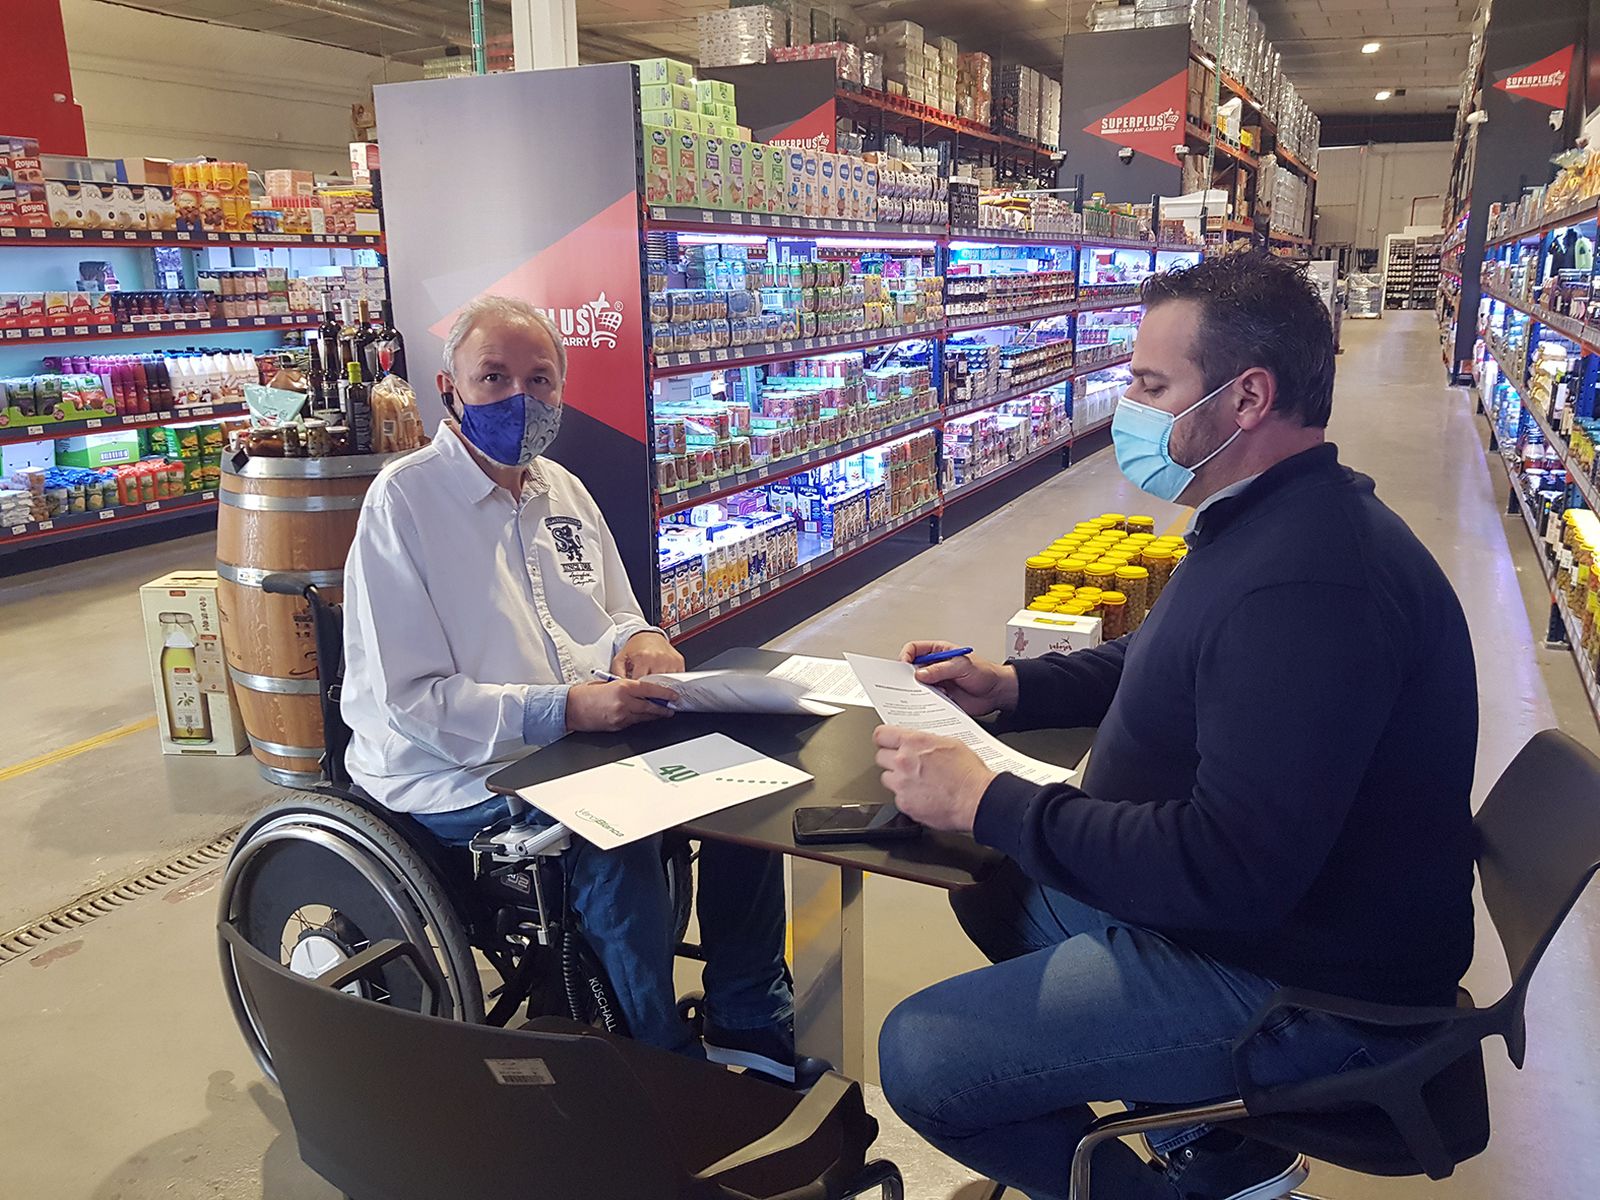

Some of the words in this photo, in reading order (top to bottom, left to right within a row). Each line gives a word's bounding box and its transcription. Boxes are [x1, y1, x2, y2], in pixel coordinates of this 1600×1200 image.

[1506, 75, 1554, 86] SUPERPLUS
[1101, 115, 1163, 129] SUPERPLUS
[15, 160, 39, 169] Royal
[21, 204, 45, 214] Royal
[562, 337, 590, 347] ARRY
[588, 976, 617, 1033] KÜSCHALL
